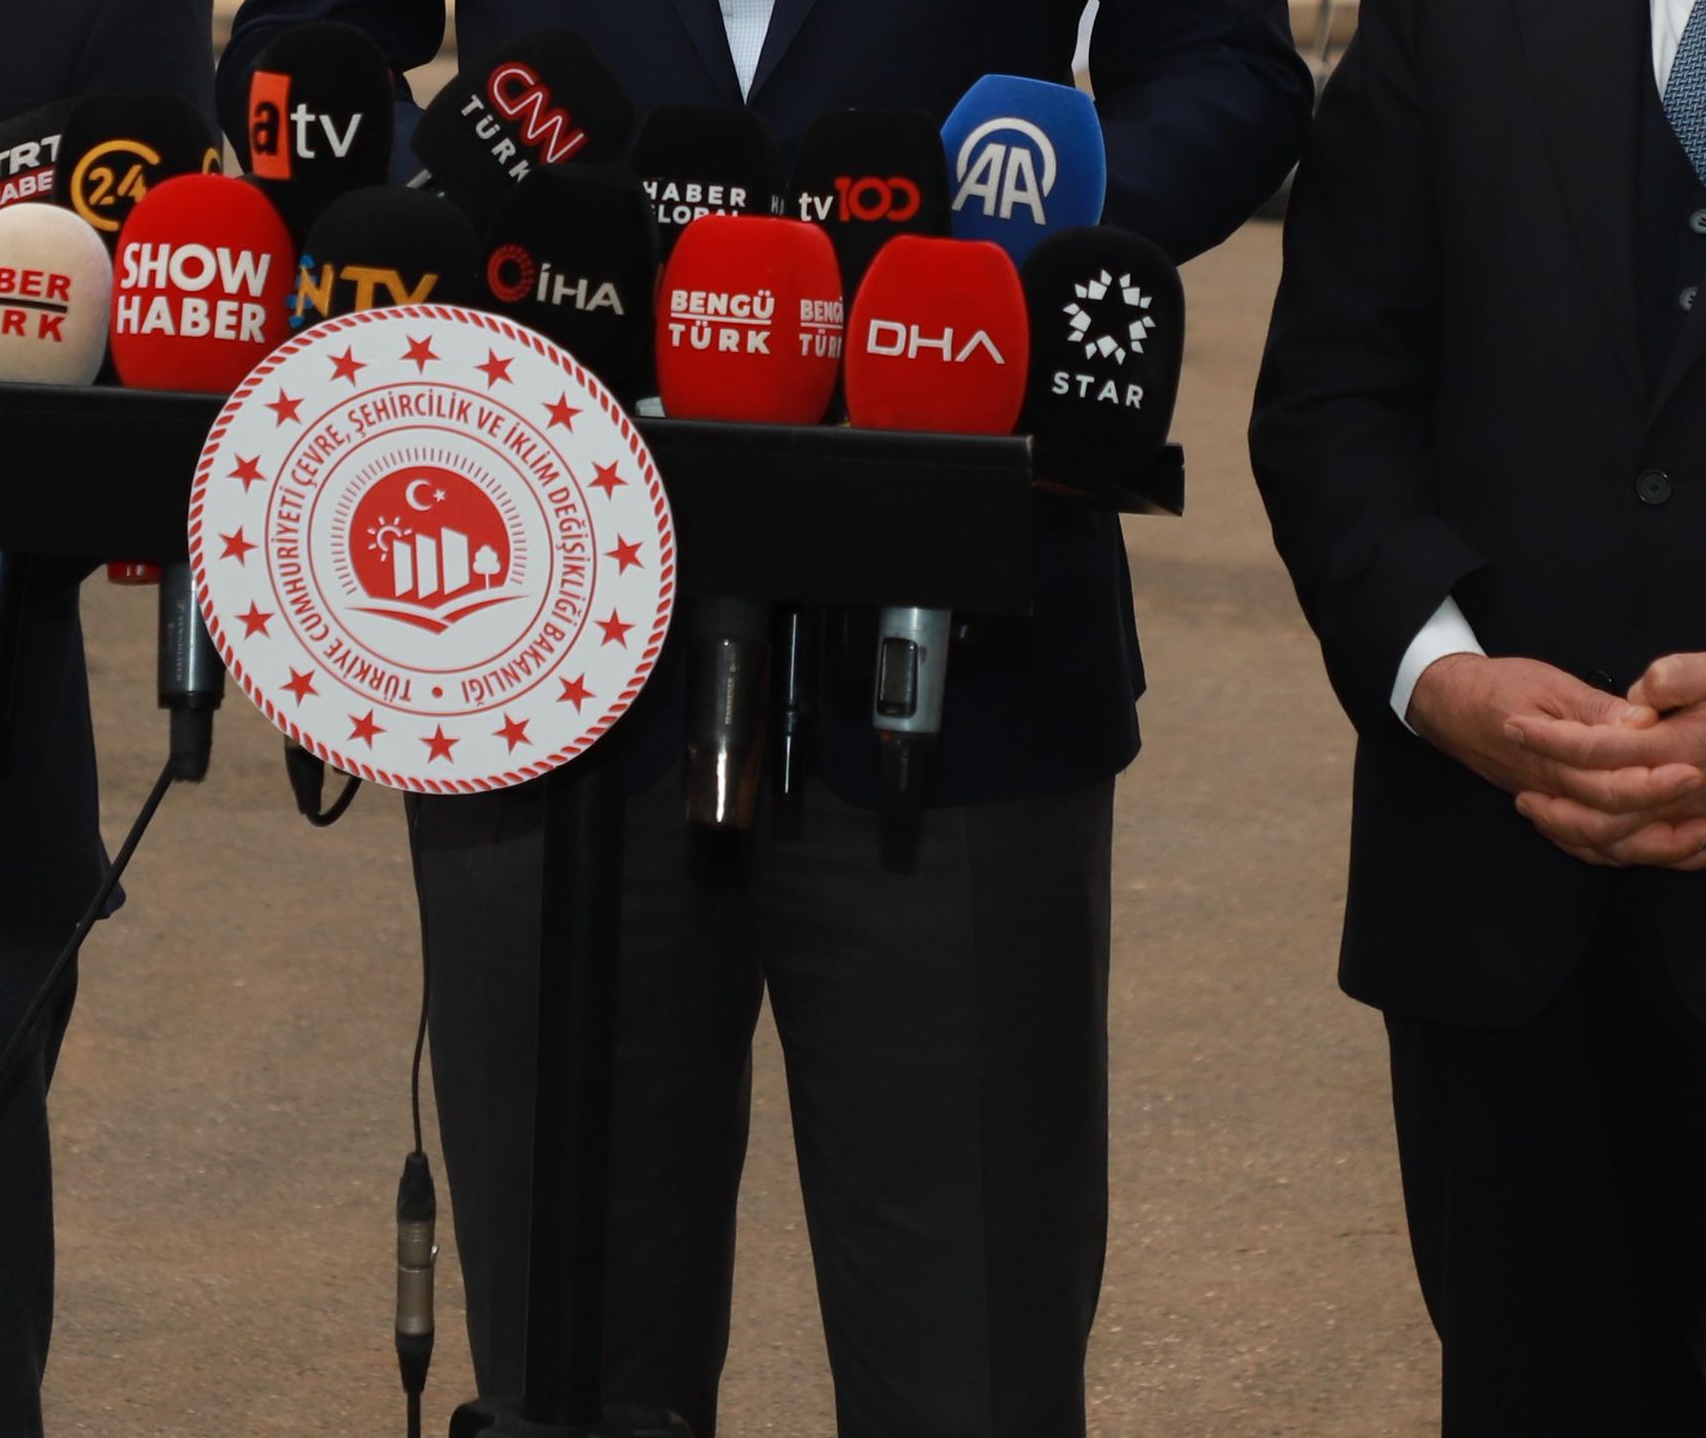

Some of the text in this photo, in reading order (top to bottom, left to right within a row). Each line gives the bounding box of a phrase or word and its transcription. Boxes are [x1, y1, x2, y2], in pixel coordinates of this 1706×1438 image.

[252, 100, 362, 160] atv
[460, 93, 532, 185] TÜRK
[88, 164, 147, 207] 24
[951, 140, 1048, 227] AA
[120, 241, 271, 298] SHOW
[295, 263, 440, 318] NTV
[116, 294, 266, 344] HABER
[669, 288, 776, 320] BENGÜ
[667, 320, 771, 355] TÜRK
[798, 327, 843, 359] TÜR
[866, 318, 1006, 365] DHA
[1051, 370, 1145, 410] STAR
[271, 387, 592, 707] TÜRKİYE CUMHURİYETİ ÇEVRE, ŞEHİRCİLİK VE İKLİM DEĞİŞİKLİĞİ BAKANLIĞI
